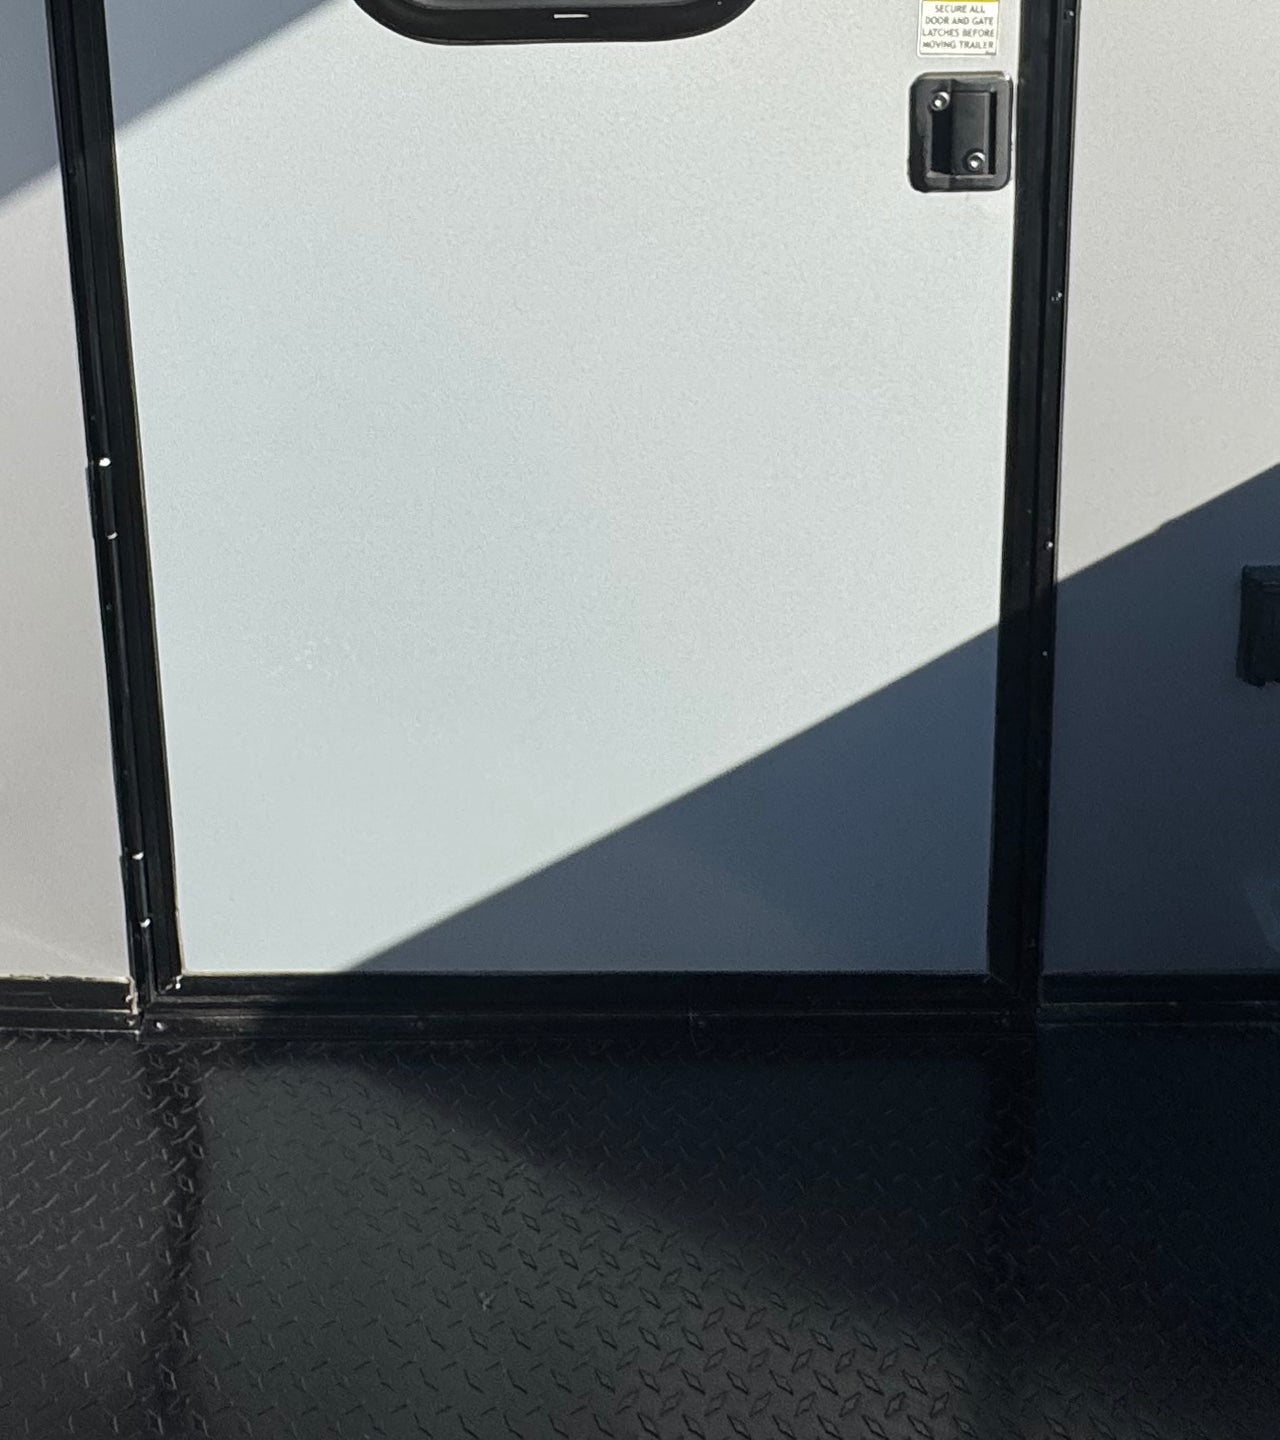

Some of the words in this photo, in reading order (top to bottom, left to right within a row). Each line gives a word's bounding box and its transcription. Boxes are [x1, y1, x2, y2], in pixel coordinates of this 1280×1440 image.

[935, 5, 967, 13] SECURE
[969, 5, 985, 13] ALL
[925, 16, 949, 25] DOOR
[952, 17, 969, 25] AND
[972, 17, 994, 25] GATE
[922, 29, 959, 37] LATCHES
[962, 29, 994, 37] BEFORE
[923, 40, 957, 49] MOVING
[960, 41, 994, 49] TRAILER
